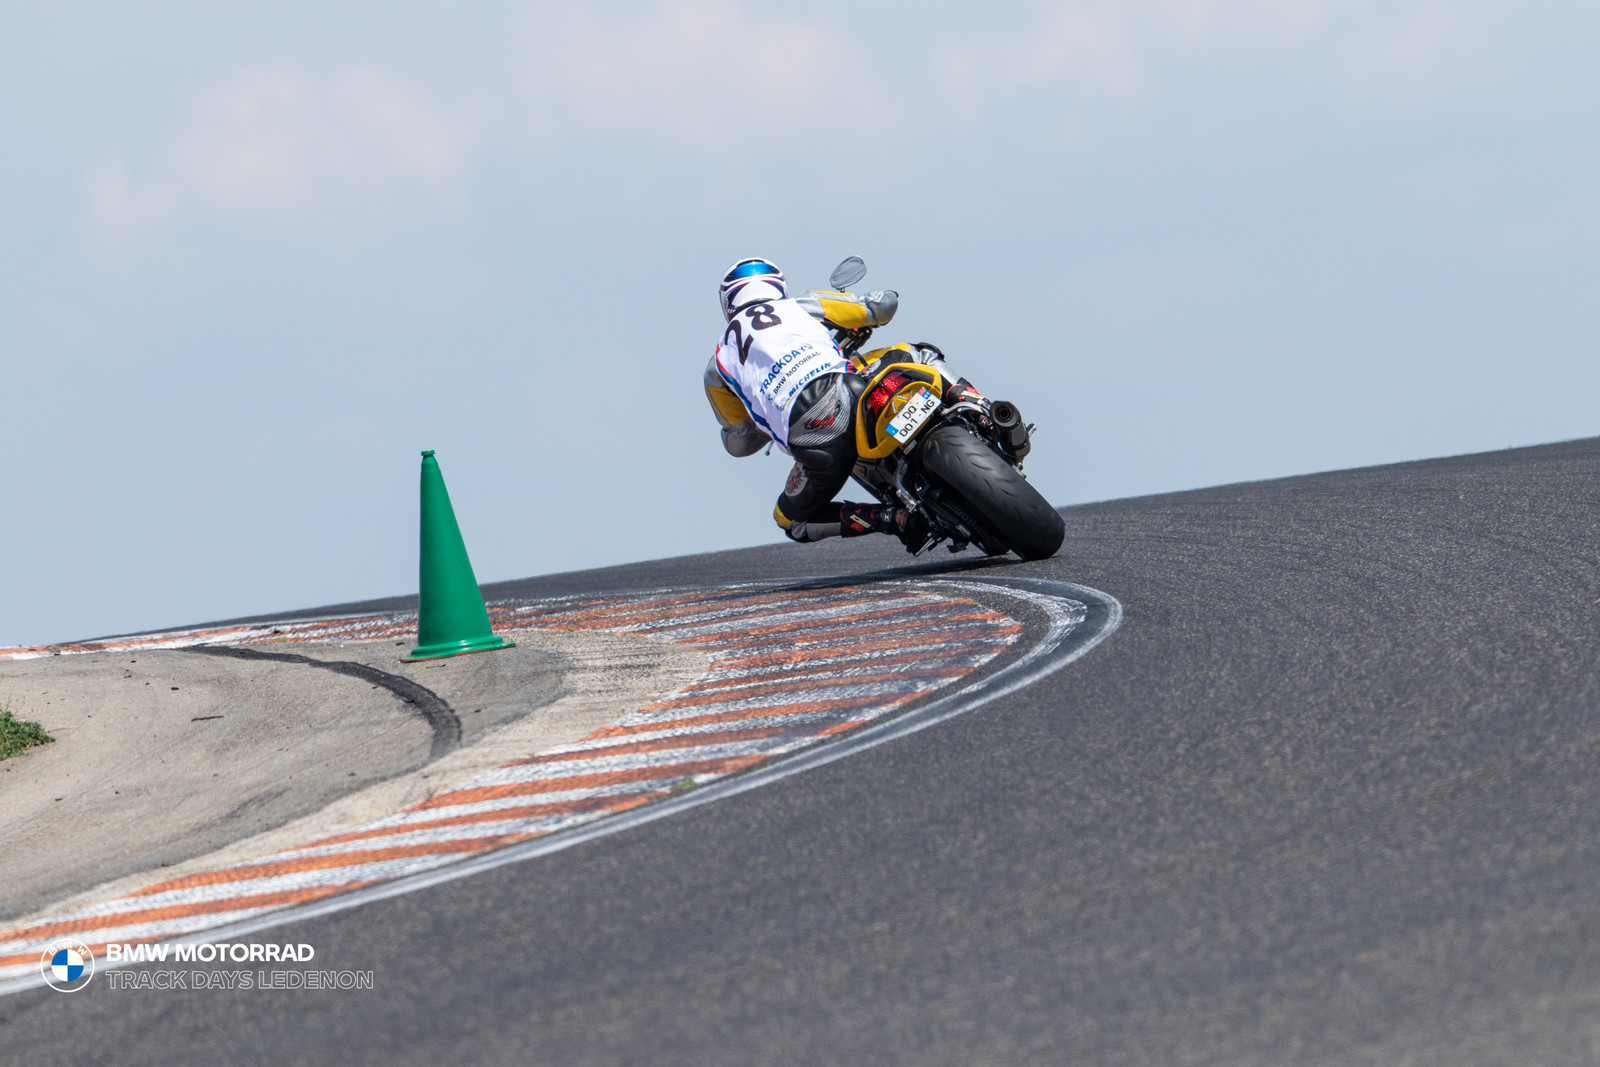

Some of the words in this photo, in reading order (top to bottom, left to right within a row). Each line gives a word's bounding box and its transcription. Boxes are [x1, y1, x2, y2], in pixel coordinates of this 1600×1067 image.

[724, 303, 782, 366] 28
[773, 377, 787, 394] BMW
[788, 362, 832, 398] MICHELIN
